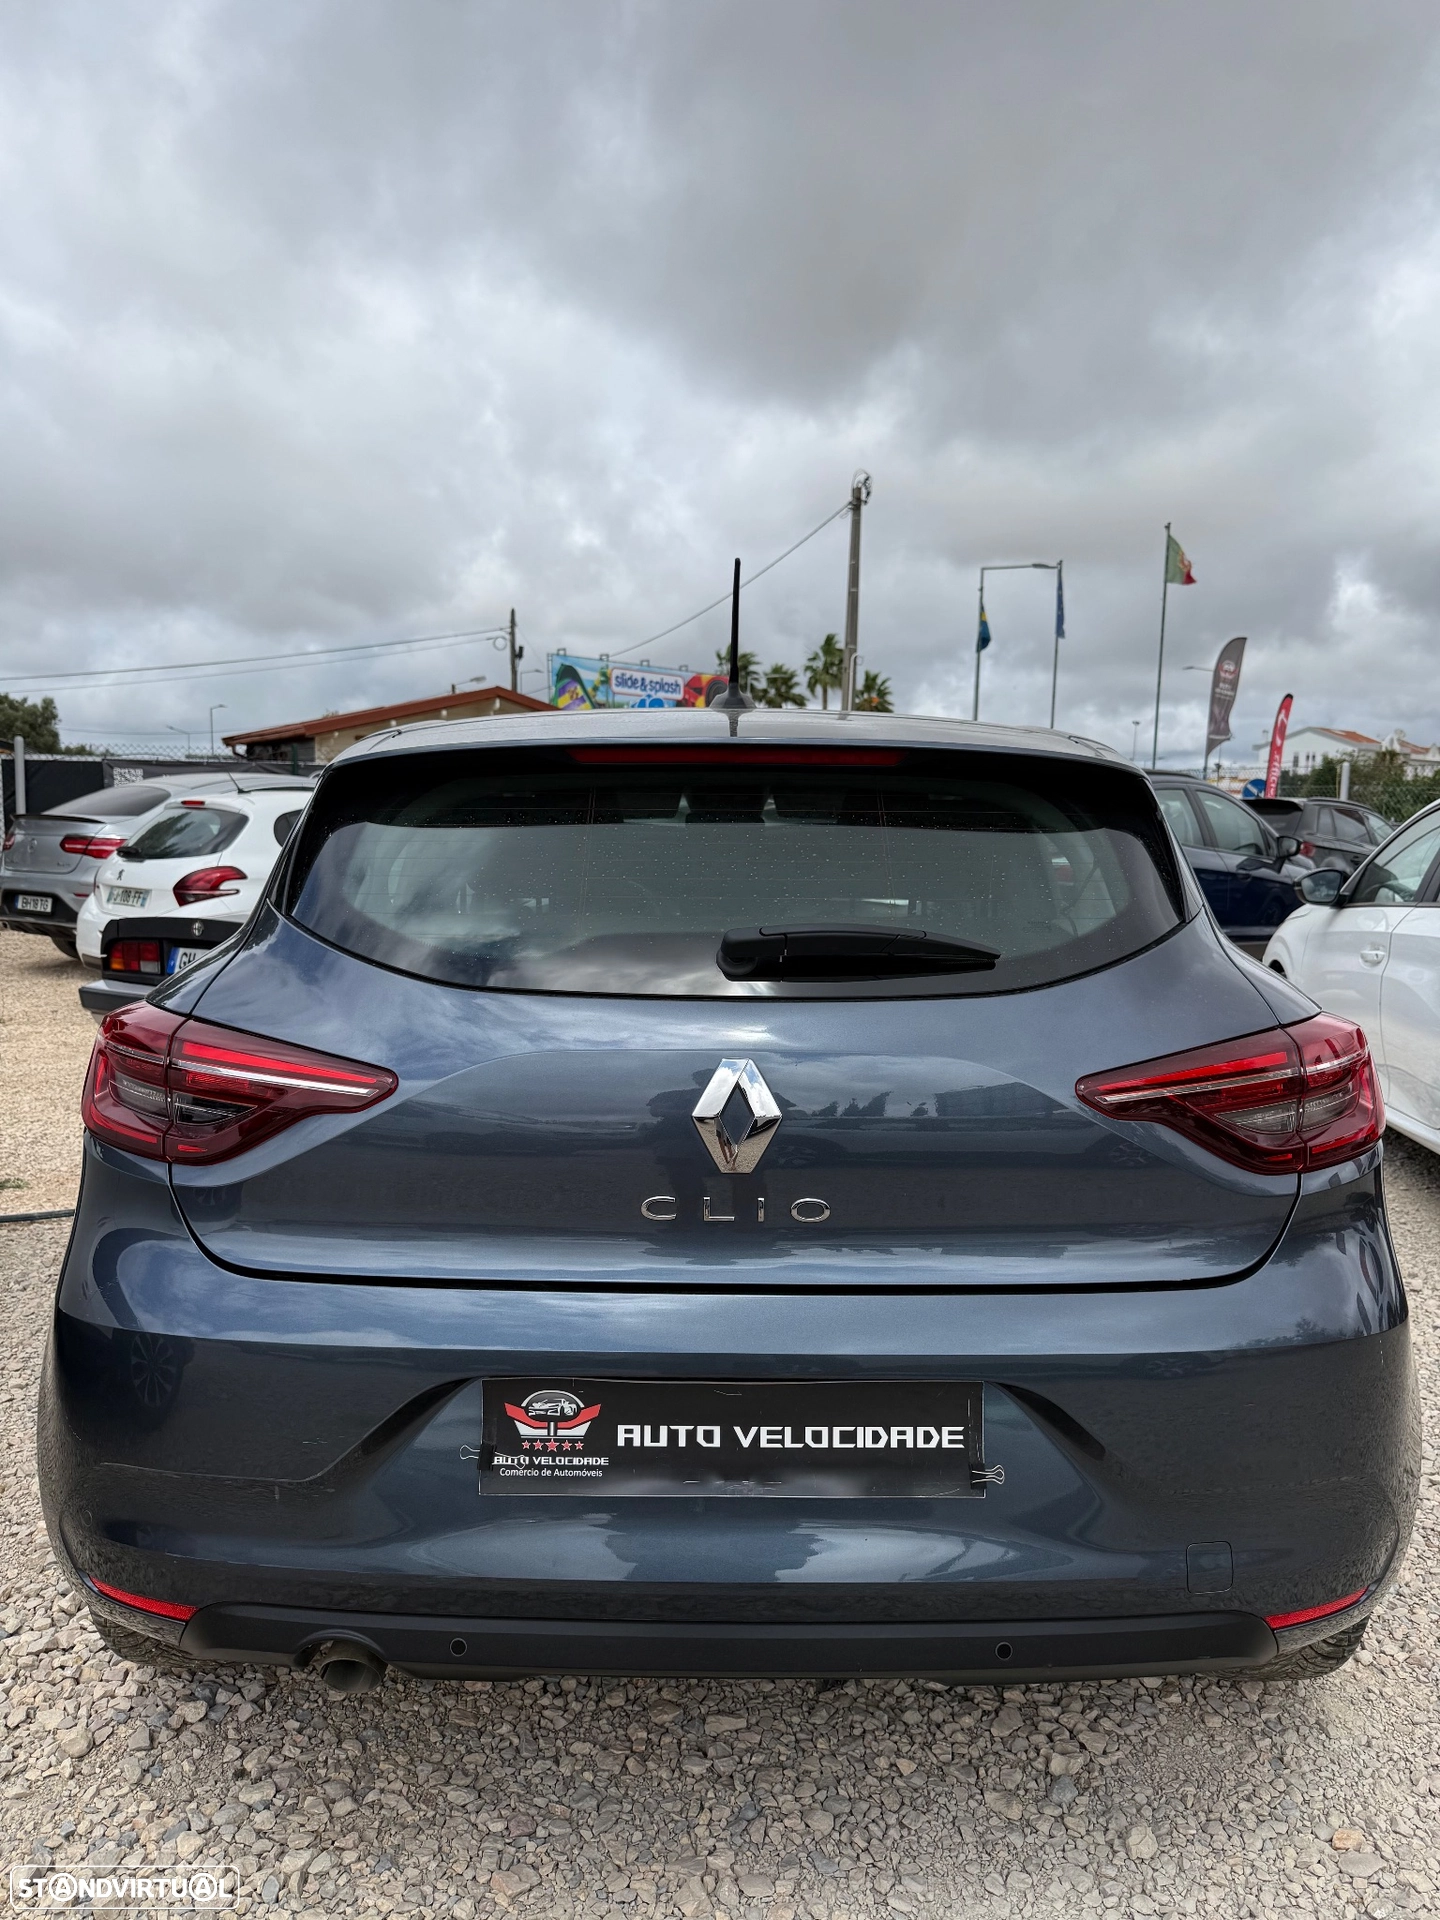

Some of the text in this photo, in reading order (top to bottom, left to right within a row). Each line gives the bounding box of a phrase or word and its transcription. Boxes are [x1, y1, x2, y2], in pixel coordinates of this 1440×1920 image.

[641, 1196, 830, 1222] CLIO
[617, 1425, 965, 1448] AUTO VELOCIDADE
[532, 1456, 609, 1465] VELOCIDADE
[541, 1468, 551, 1476] de
[553, 1468, 603, 1477] Automóveis
